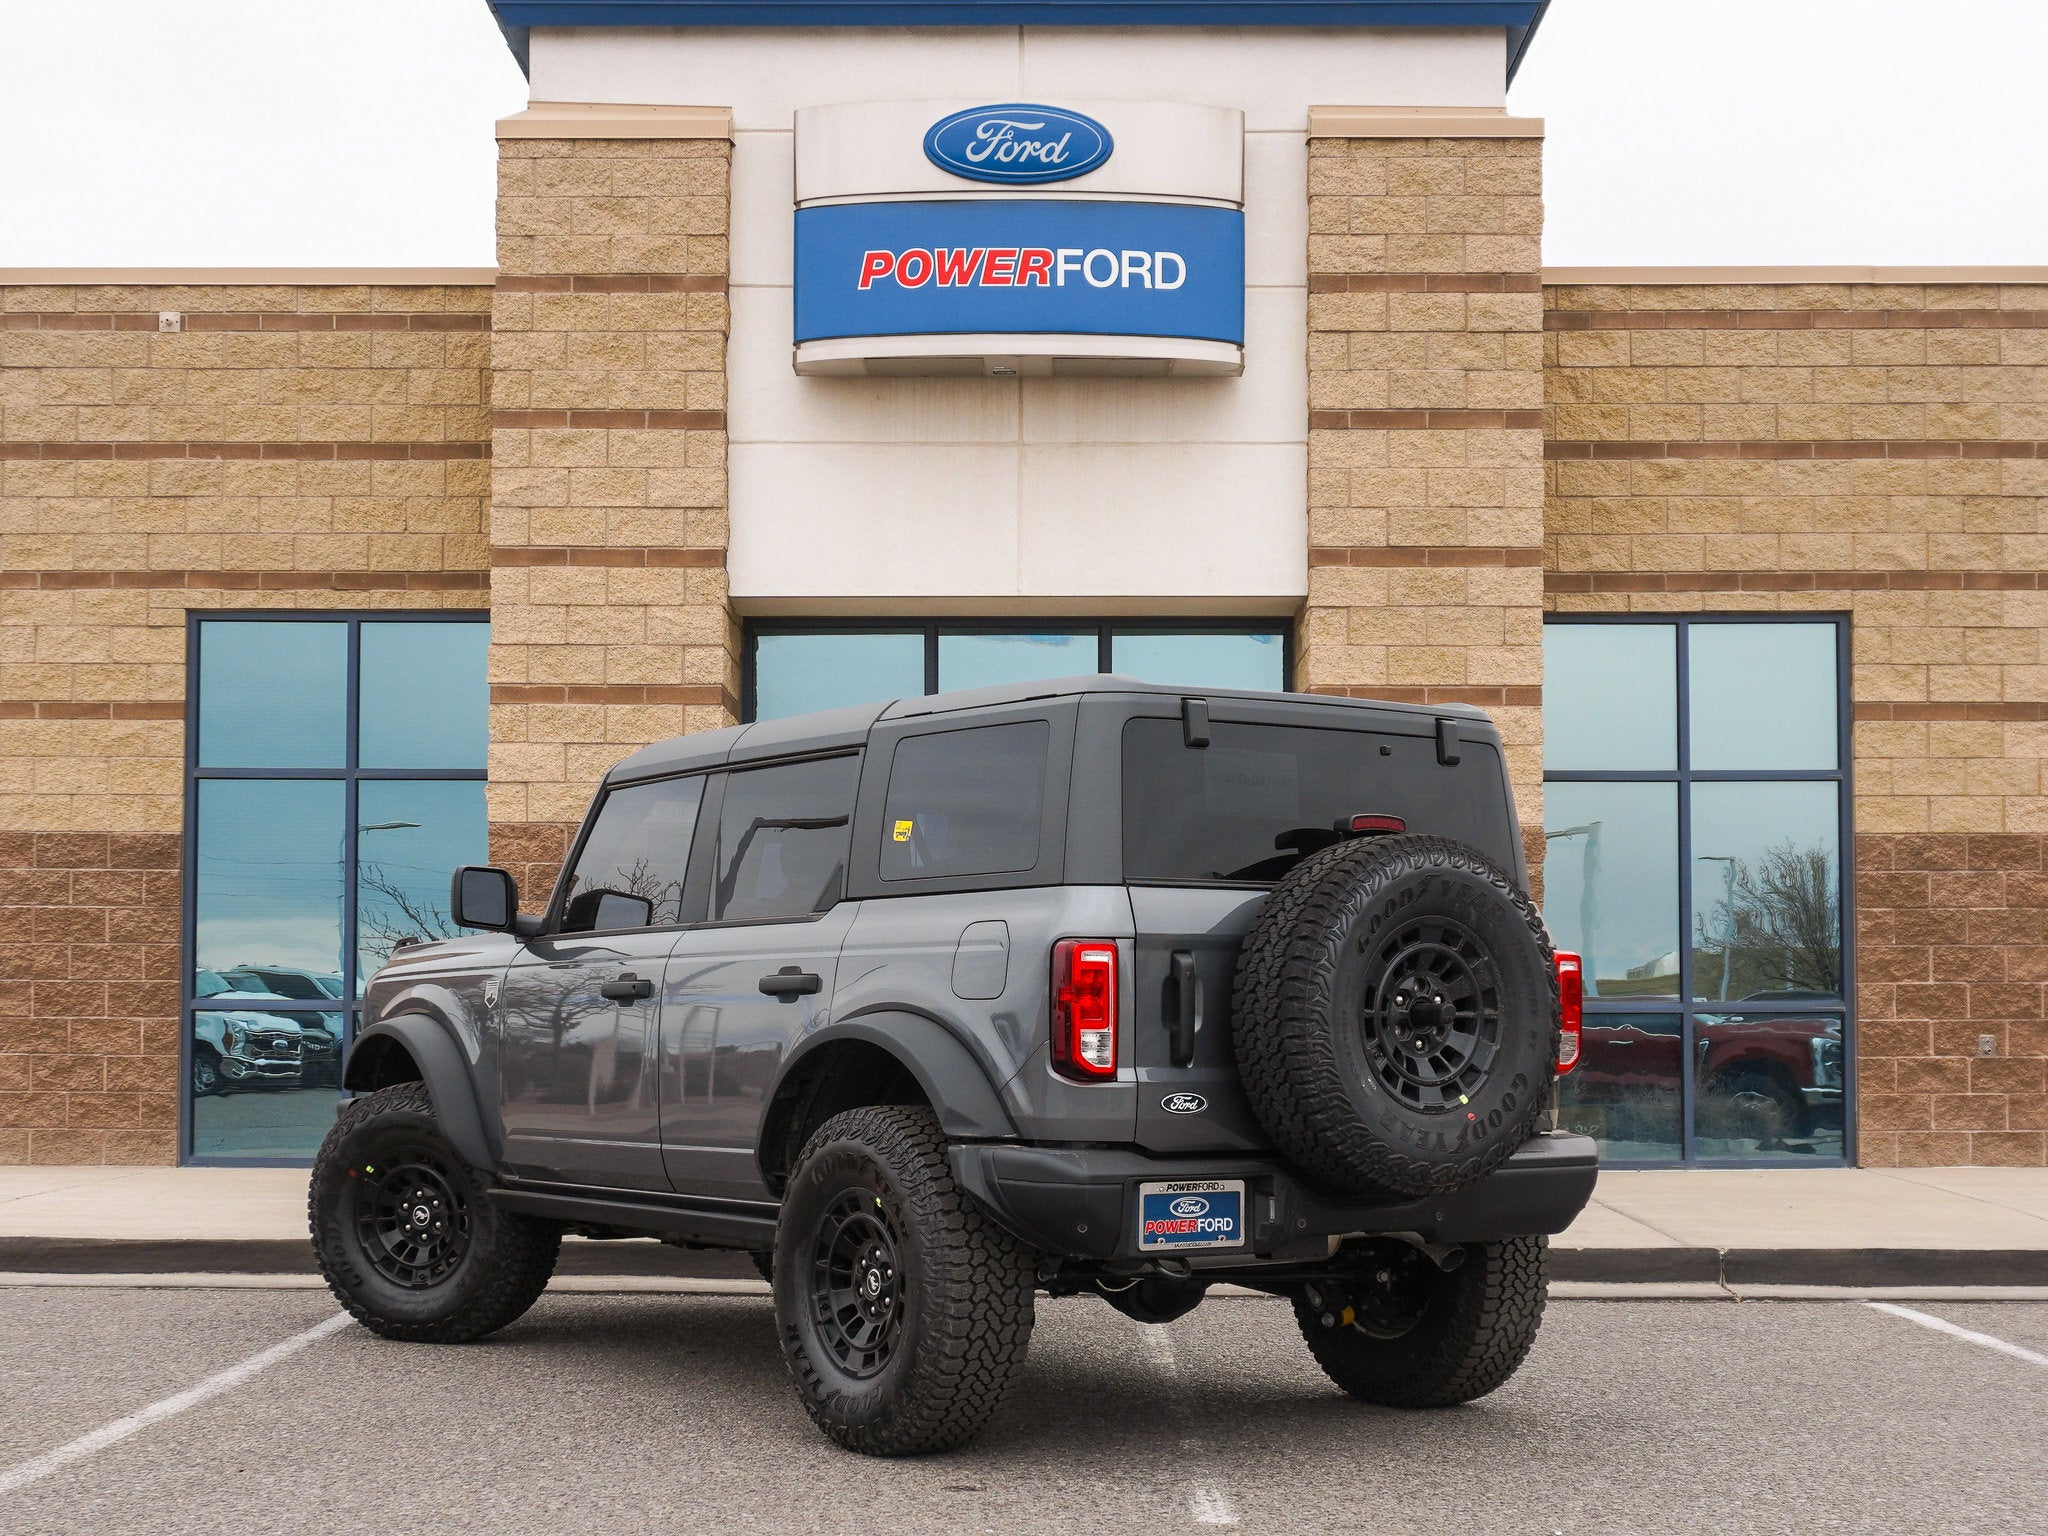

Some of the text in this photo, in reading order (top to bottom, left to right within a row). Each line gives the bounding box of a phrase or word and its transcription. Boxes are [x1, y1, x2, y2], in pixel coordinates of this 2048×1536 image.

[965, 119, 1072, 164] Ford
[857, 247, 1188, 290] POWERFORD
[1169, 1095, 1199, 1110] Ford
[1165, 1182, 1220, 1192] POWERFORD
[1177, 1200, 1202, 1213] Ford
[1144, 1217, 1233, 1235] POWERFORD
